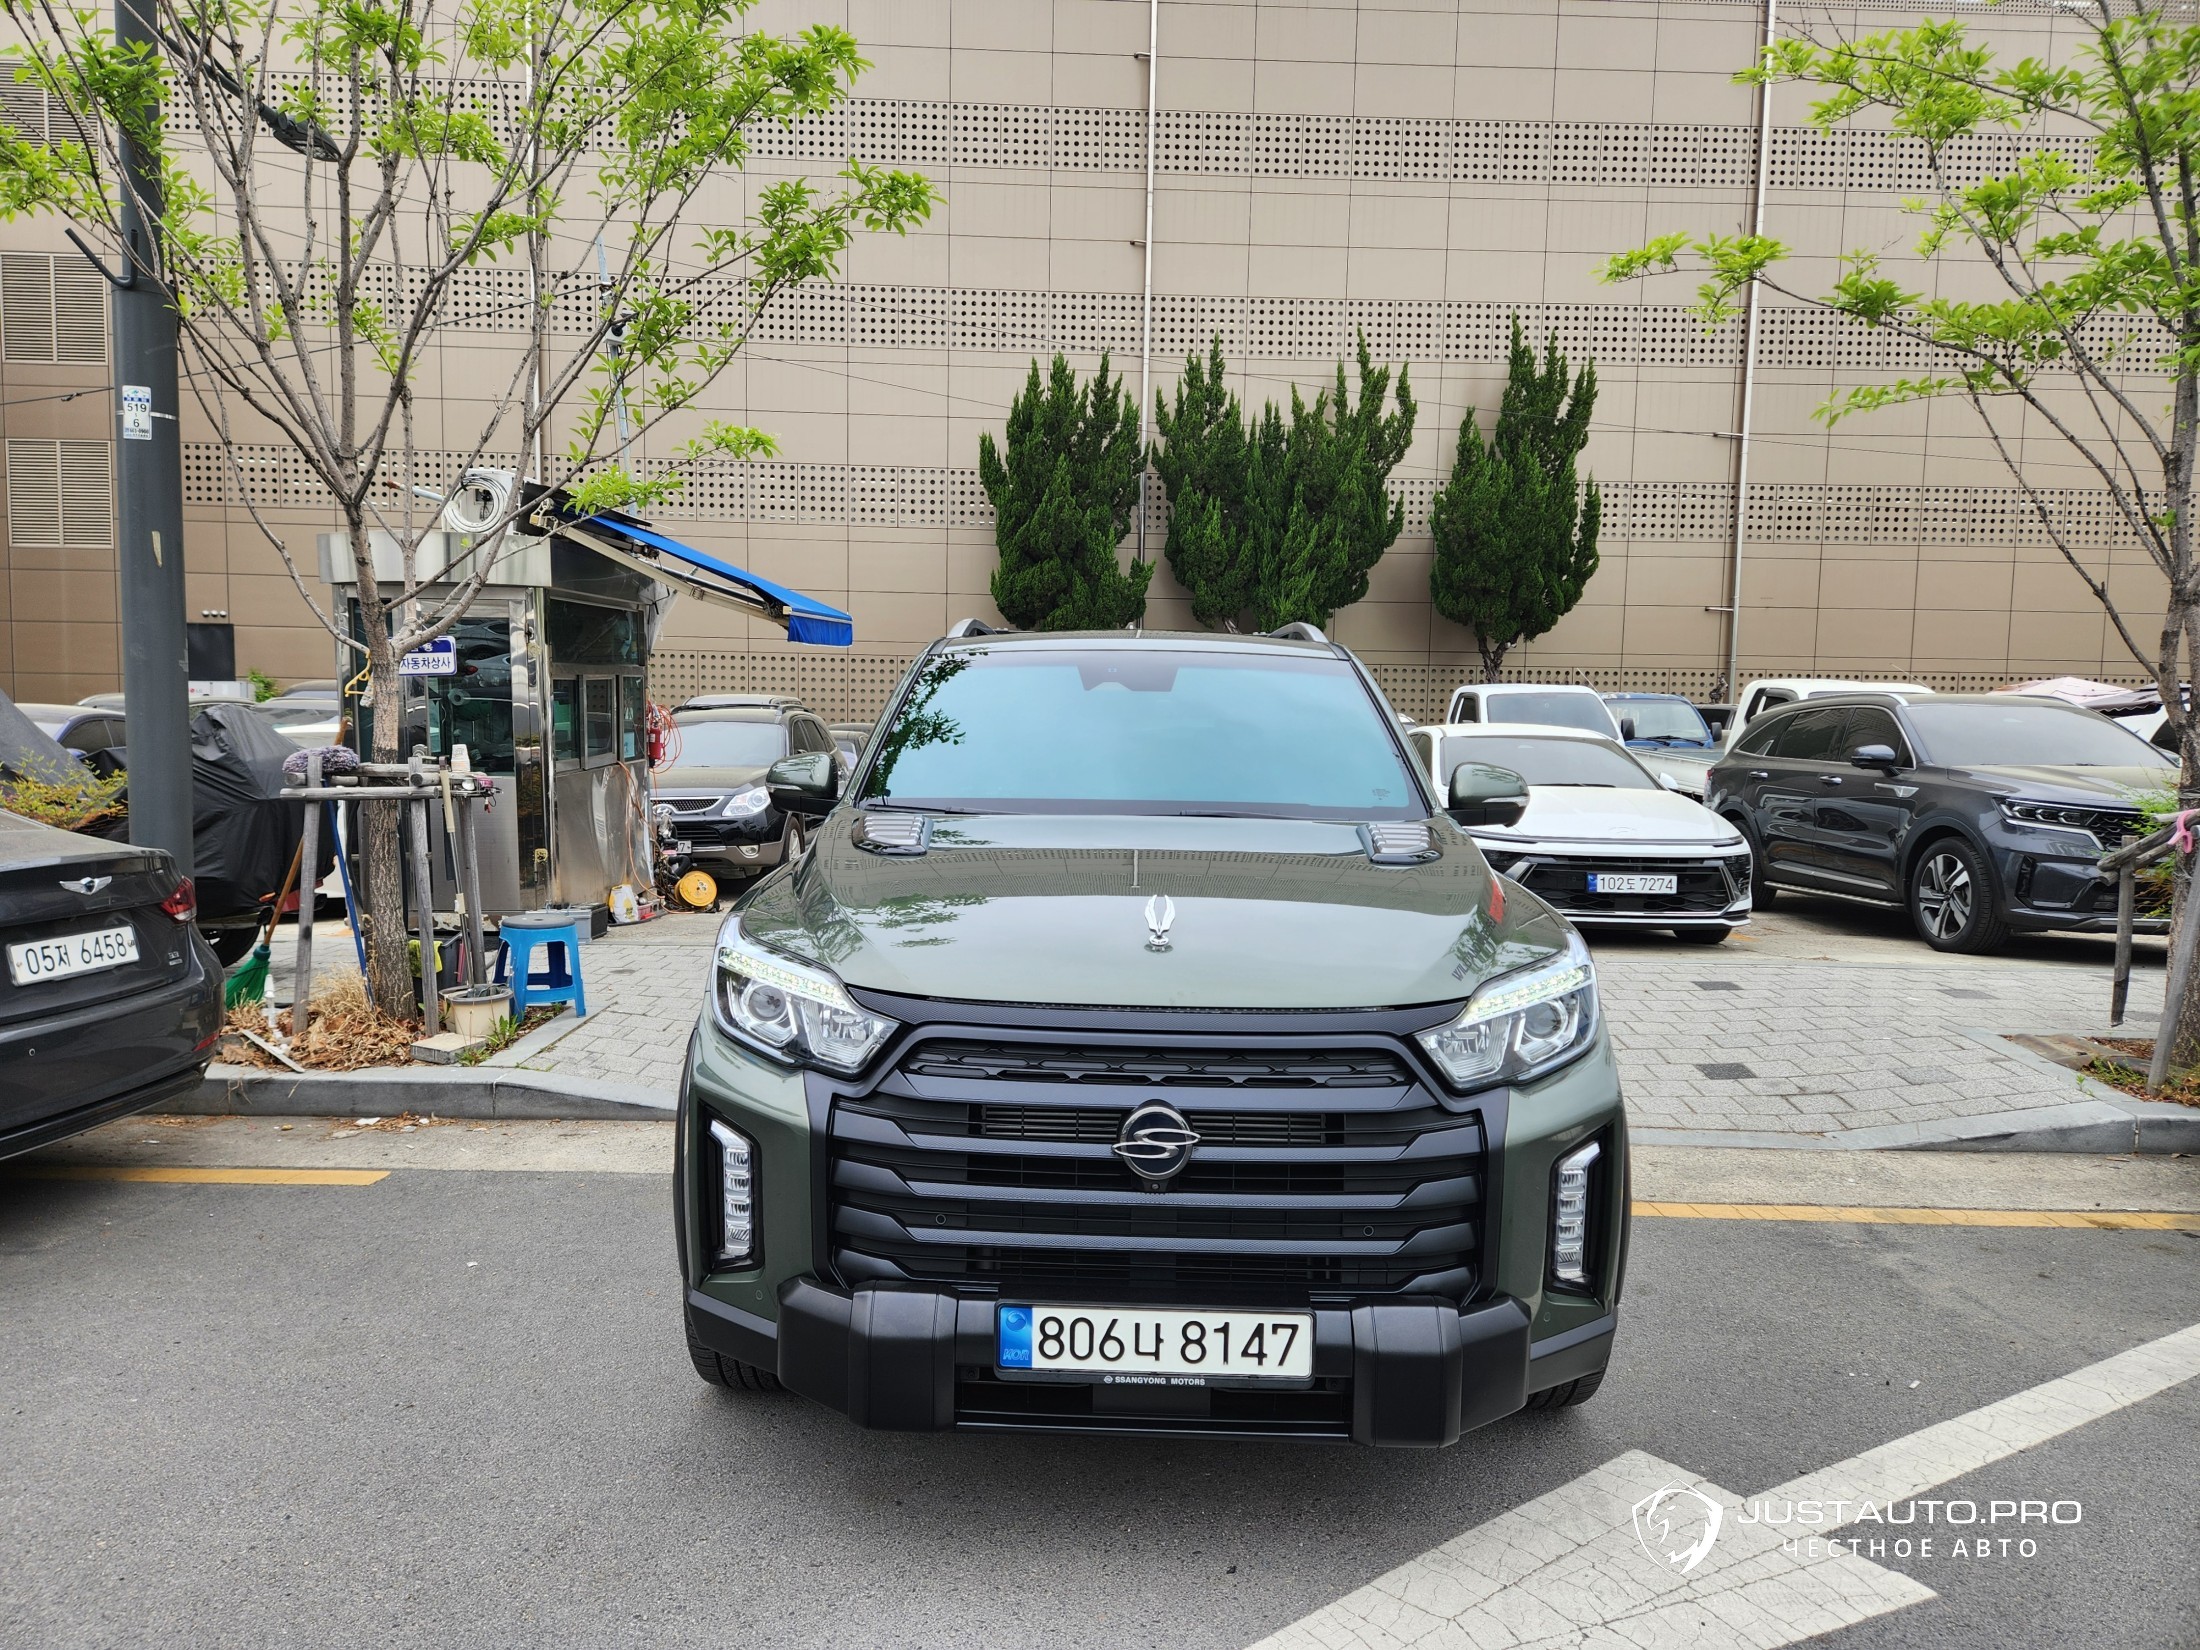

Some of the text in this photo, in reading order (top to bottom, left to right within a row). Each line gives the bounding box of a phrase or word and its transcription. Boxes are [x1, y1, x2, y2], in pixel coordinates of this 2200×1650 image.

[127, 403, 147, 412] 519
[133, 418, 140, 428] 6
[401, 656, 451, 670] 자동차상사
[1600, 876, 1674, 891] 102도 7274
[25, 932, 128, 975] 05저 6458
[1038, 1316, 1300, 1367] 806나 8147
[1002, 1348, 1030, 1361] KOR
[1115, 1376, 1206, 1386] SSANGYONG MOTORS
